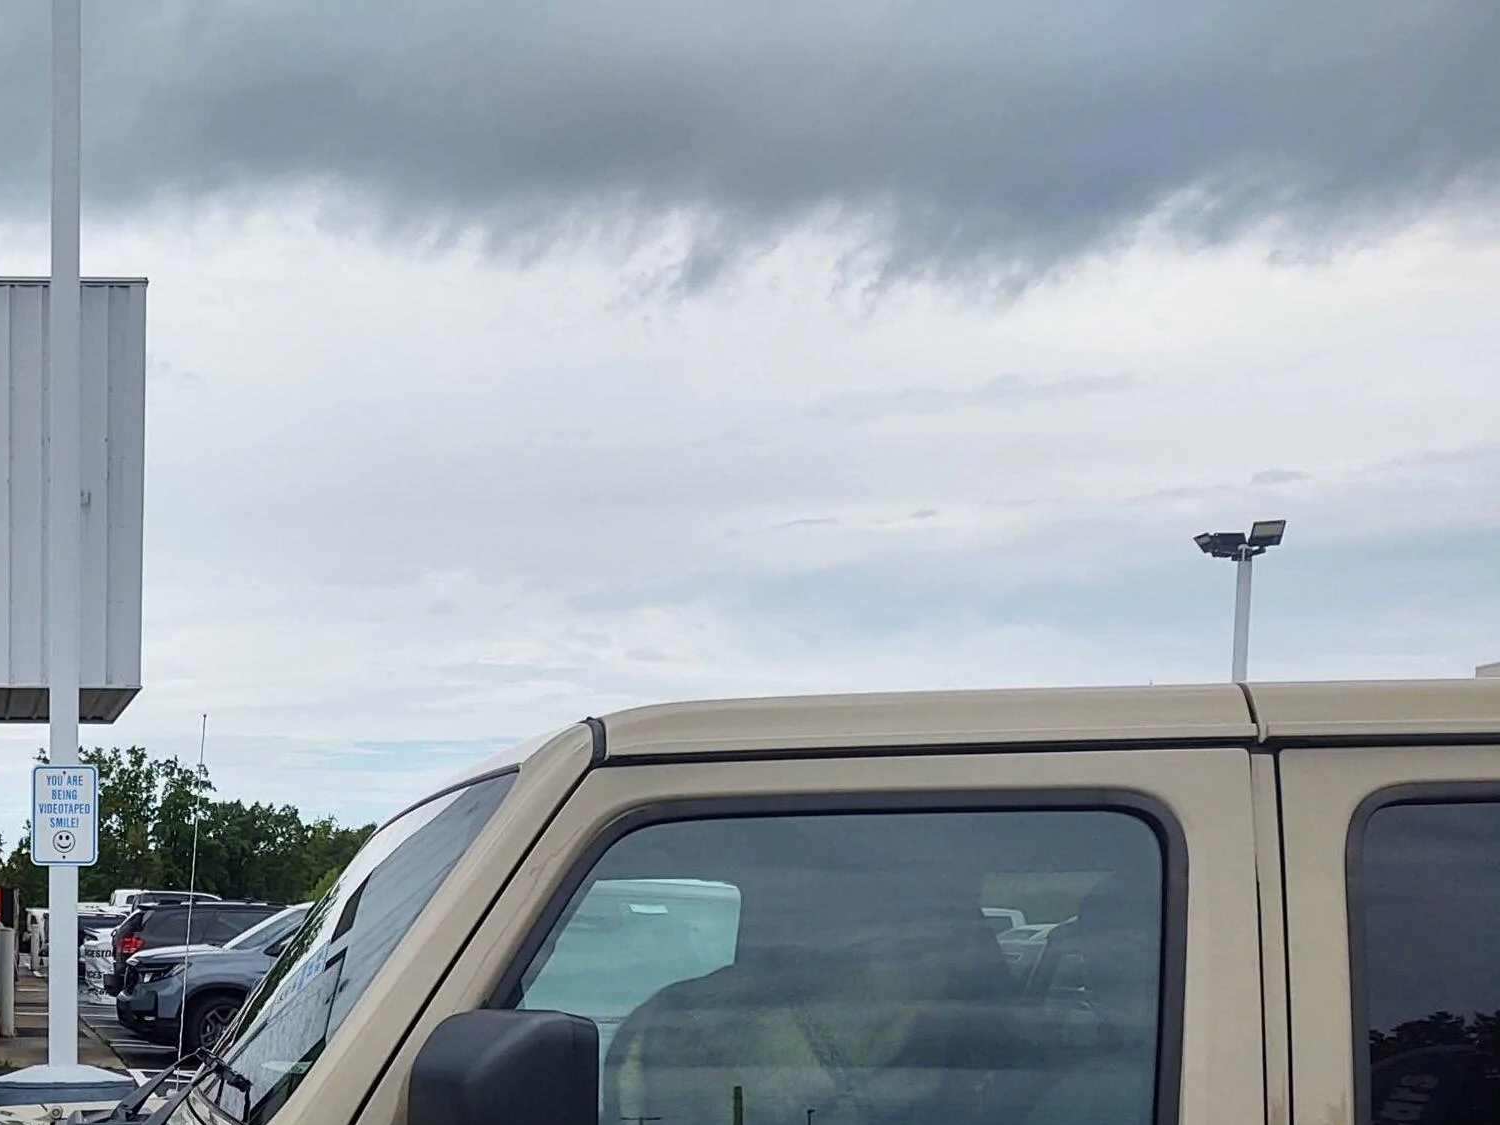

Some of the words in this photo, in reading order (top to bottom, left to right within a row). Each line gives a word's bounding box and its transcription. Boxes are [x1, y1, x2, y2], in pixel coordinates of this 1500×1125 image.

[46, 775, 63, 787] YOU
[66, 775, 84, 787] ARE
[51, 789, 78, 800] BEING
[38, 803, 91, 815] VIDEOTAPED
[49, 817, 79, 829] SMILE!
